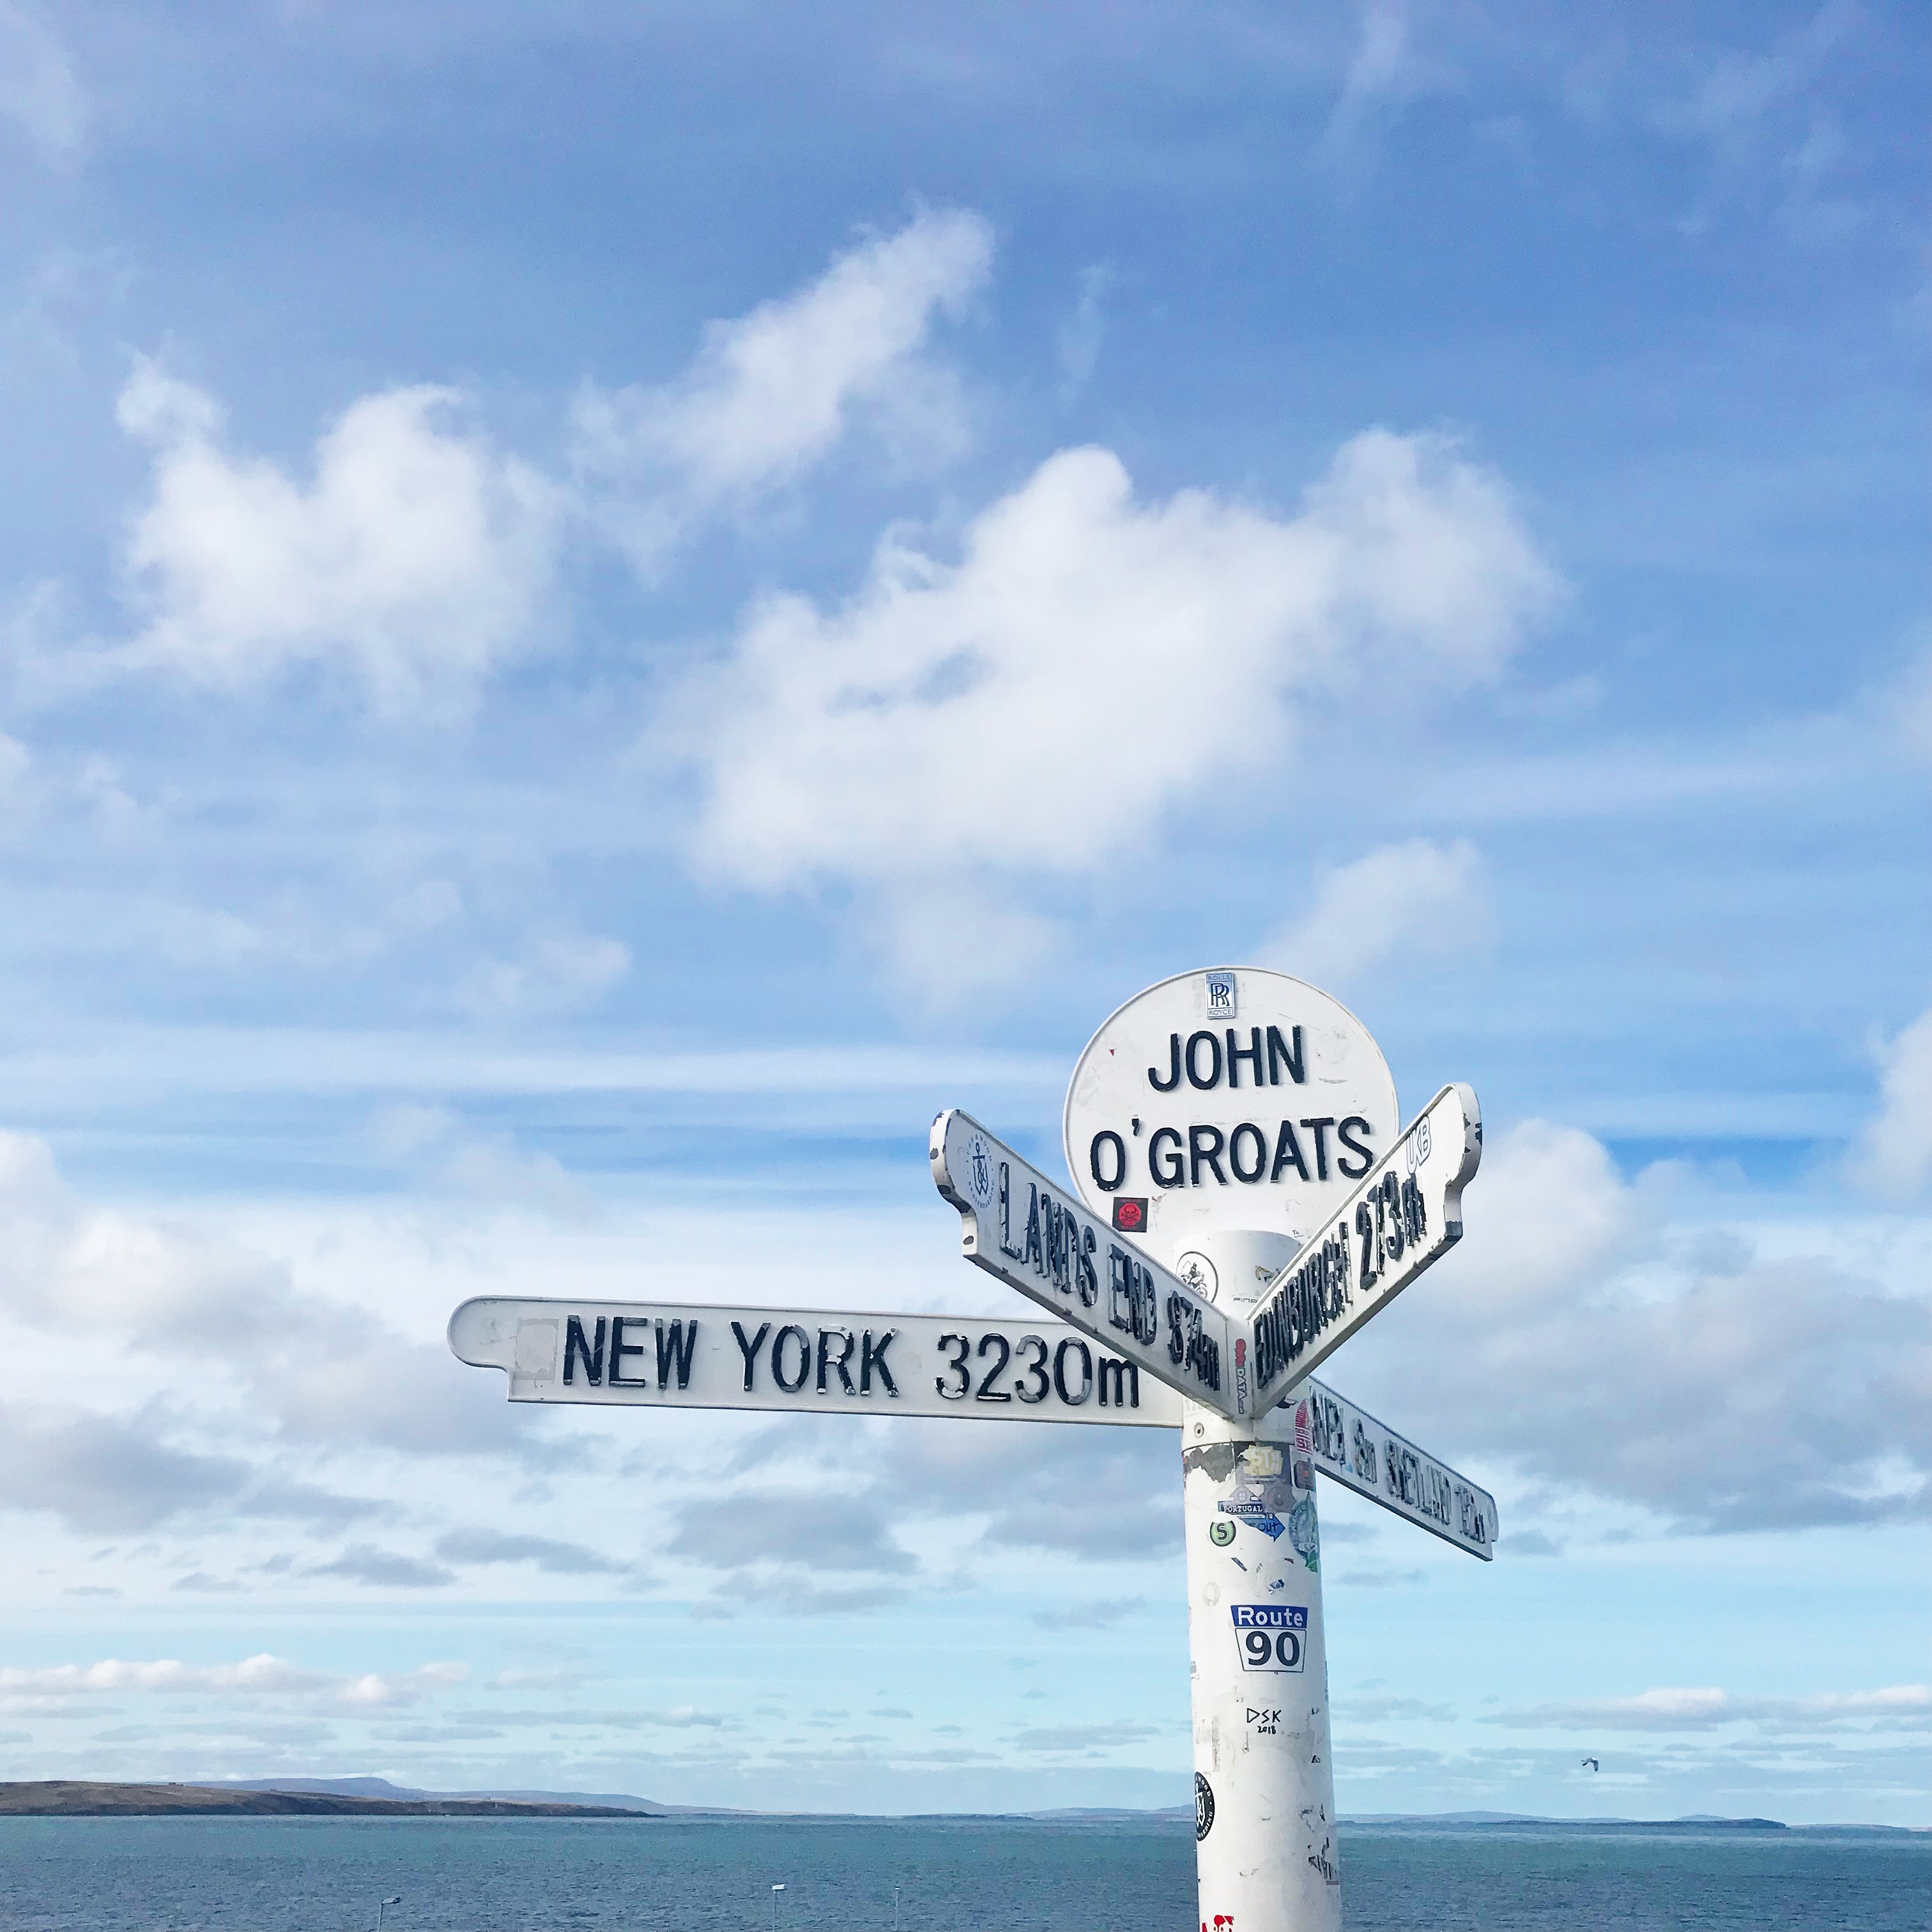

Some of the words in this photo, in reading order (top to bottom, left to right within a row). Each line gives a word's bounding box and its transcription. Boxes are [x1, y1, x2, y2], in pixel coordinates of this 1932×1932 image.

[1148, 1025, 1305, 1092] JOHN
[1090, 1116, 1374, 1191] O'GROATS
[999, 1162, 1098, 1307] LANDS
[1108, 1244, 1157, 1345] END
[1254, 1221, 1353, 1389] EDINBURGH
[563, 1315, 698, 1389] NEW
[730, 1321, 899, 1397] YORK
[935, 1331, 1140, 1407] 3230m
[1223, 1505, 1263, 1513] PORTUGAL
[1238, 1607, 1303, 1627] Route
[1246, 1630, 1300, 1666] 90
[1246, 1708, 1282, 1724] DSK
[1257, 1725, 1276, 1735] 2018
